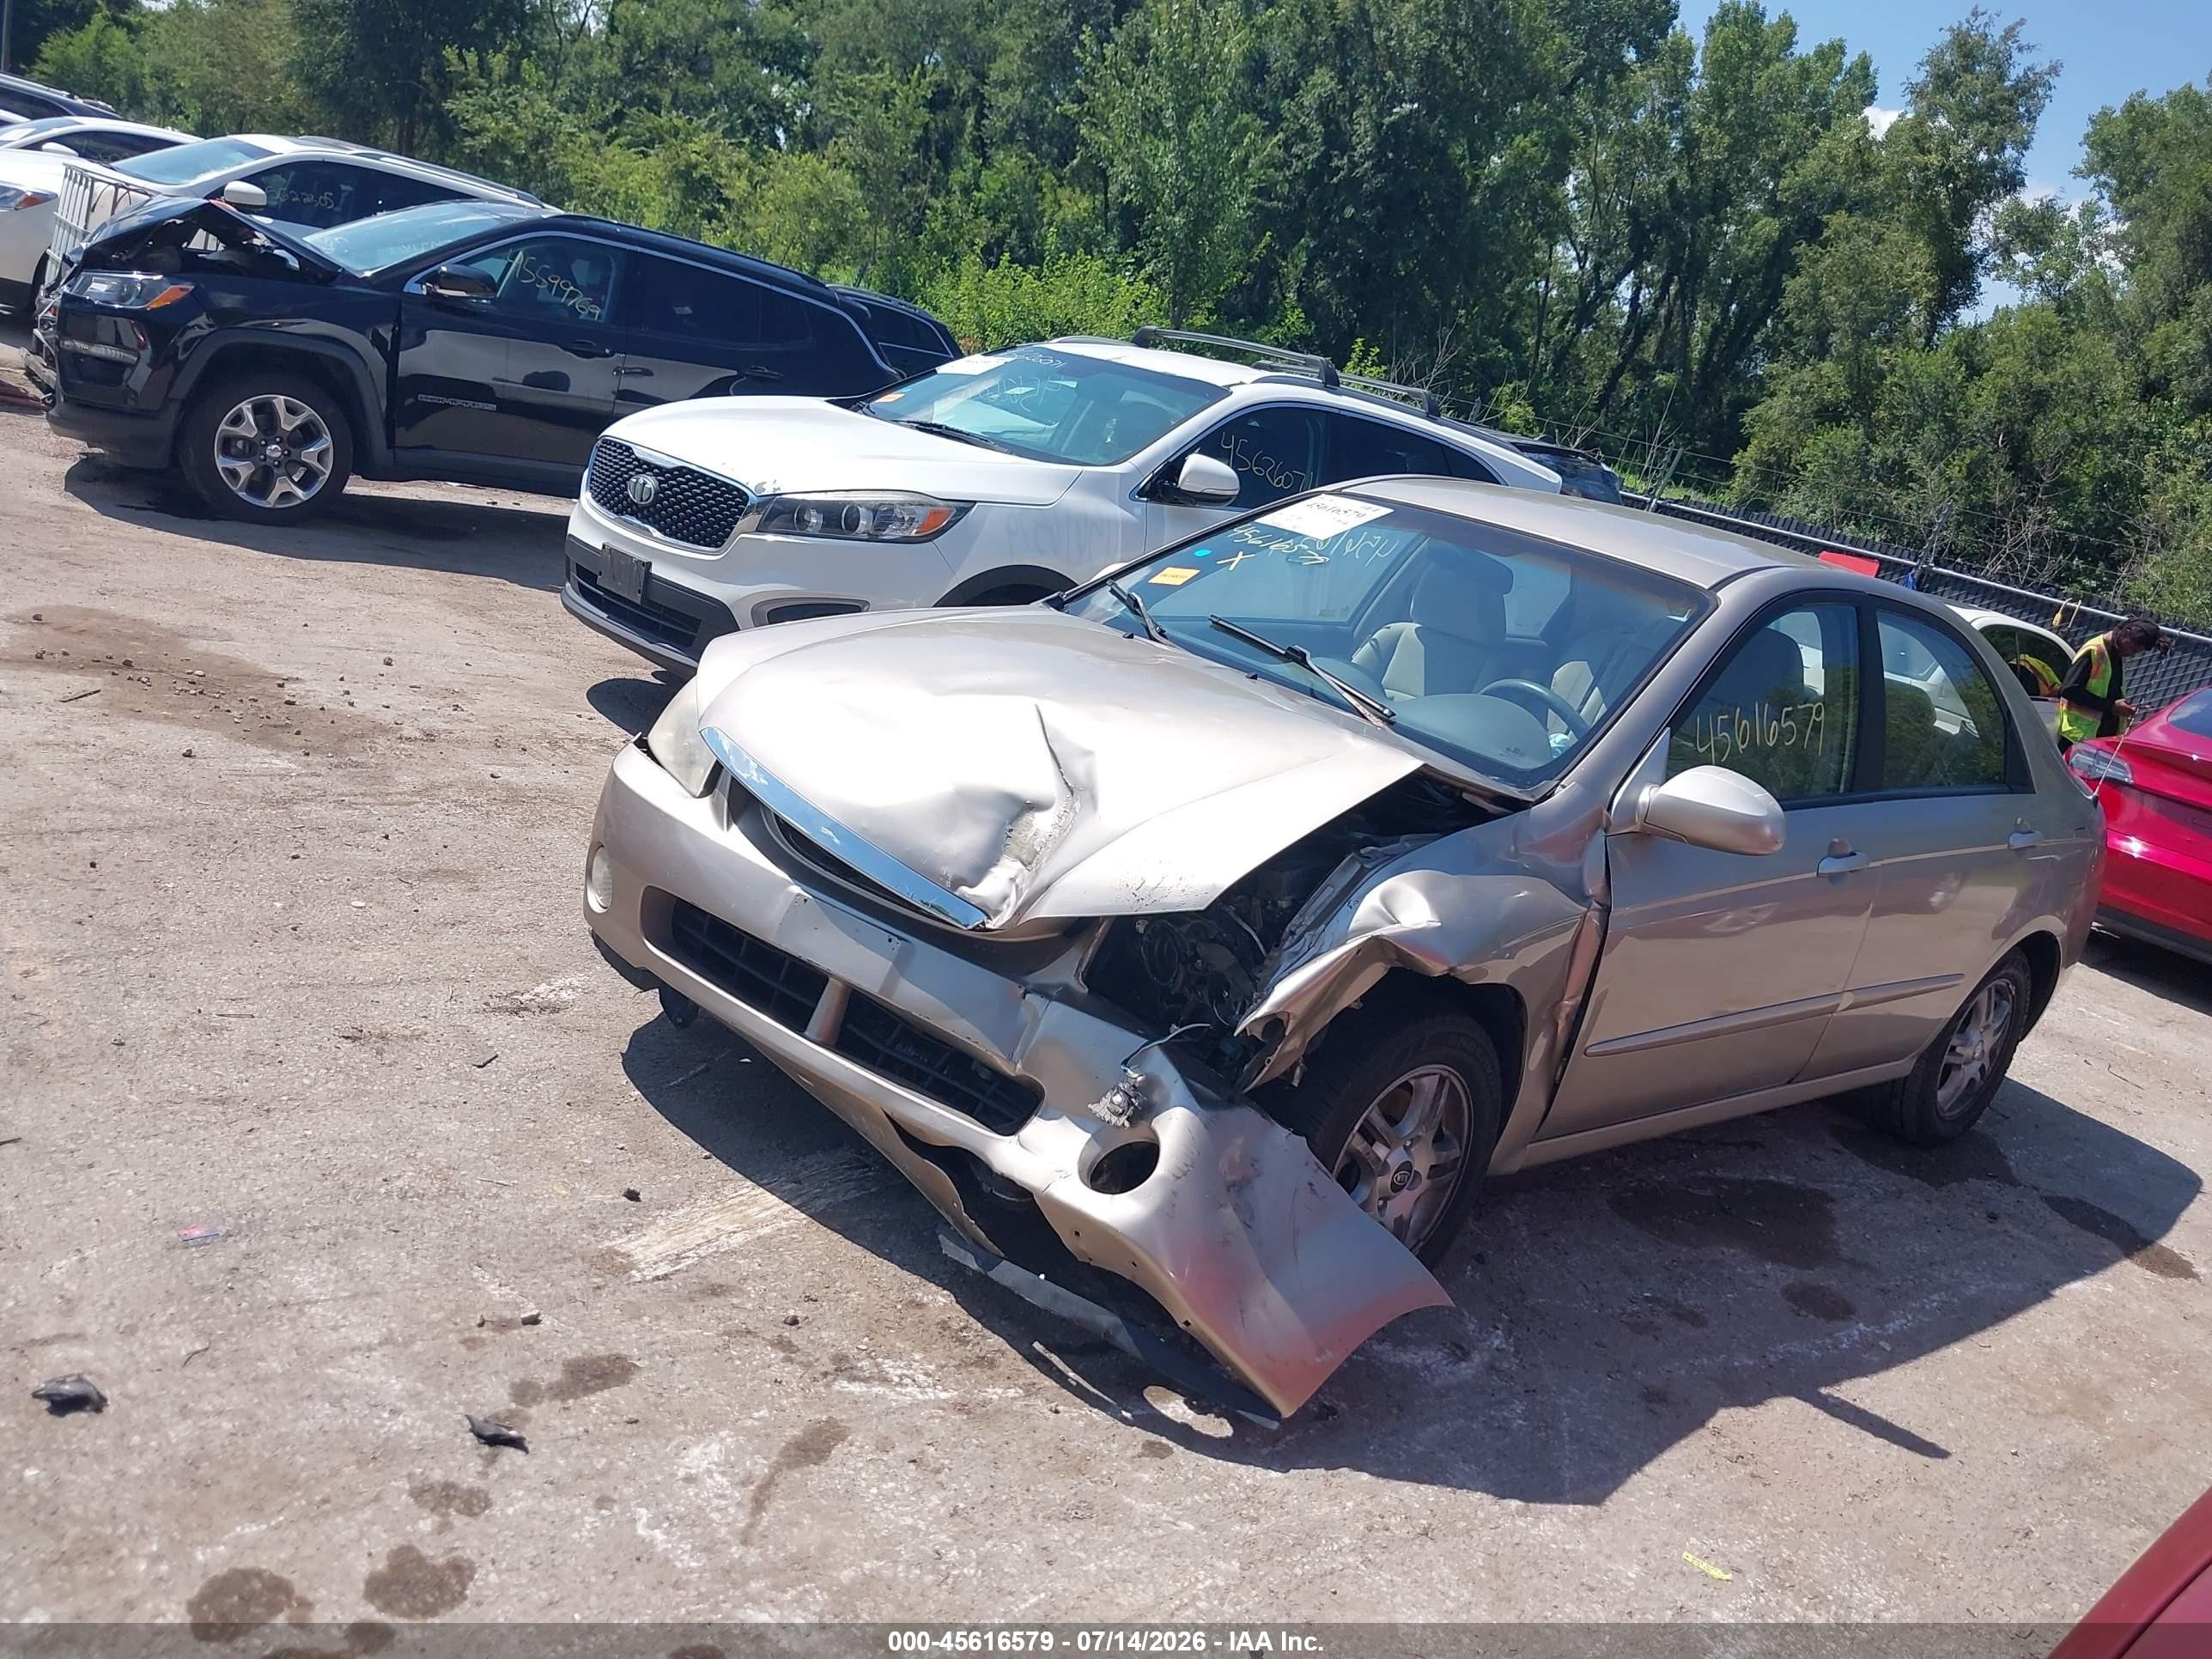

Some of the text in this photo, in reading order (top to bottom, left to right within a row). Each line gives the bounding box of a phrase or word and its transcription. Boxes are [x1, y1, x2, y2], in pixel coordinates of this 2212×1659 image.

[507, 247, 602, 321] 45599769
[1220, 431, 1314, 493] 45626071
[1696, 700, 1826, 764] 45616579
